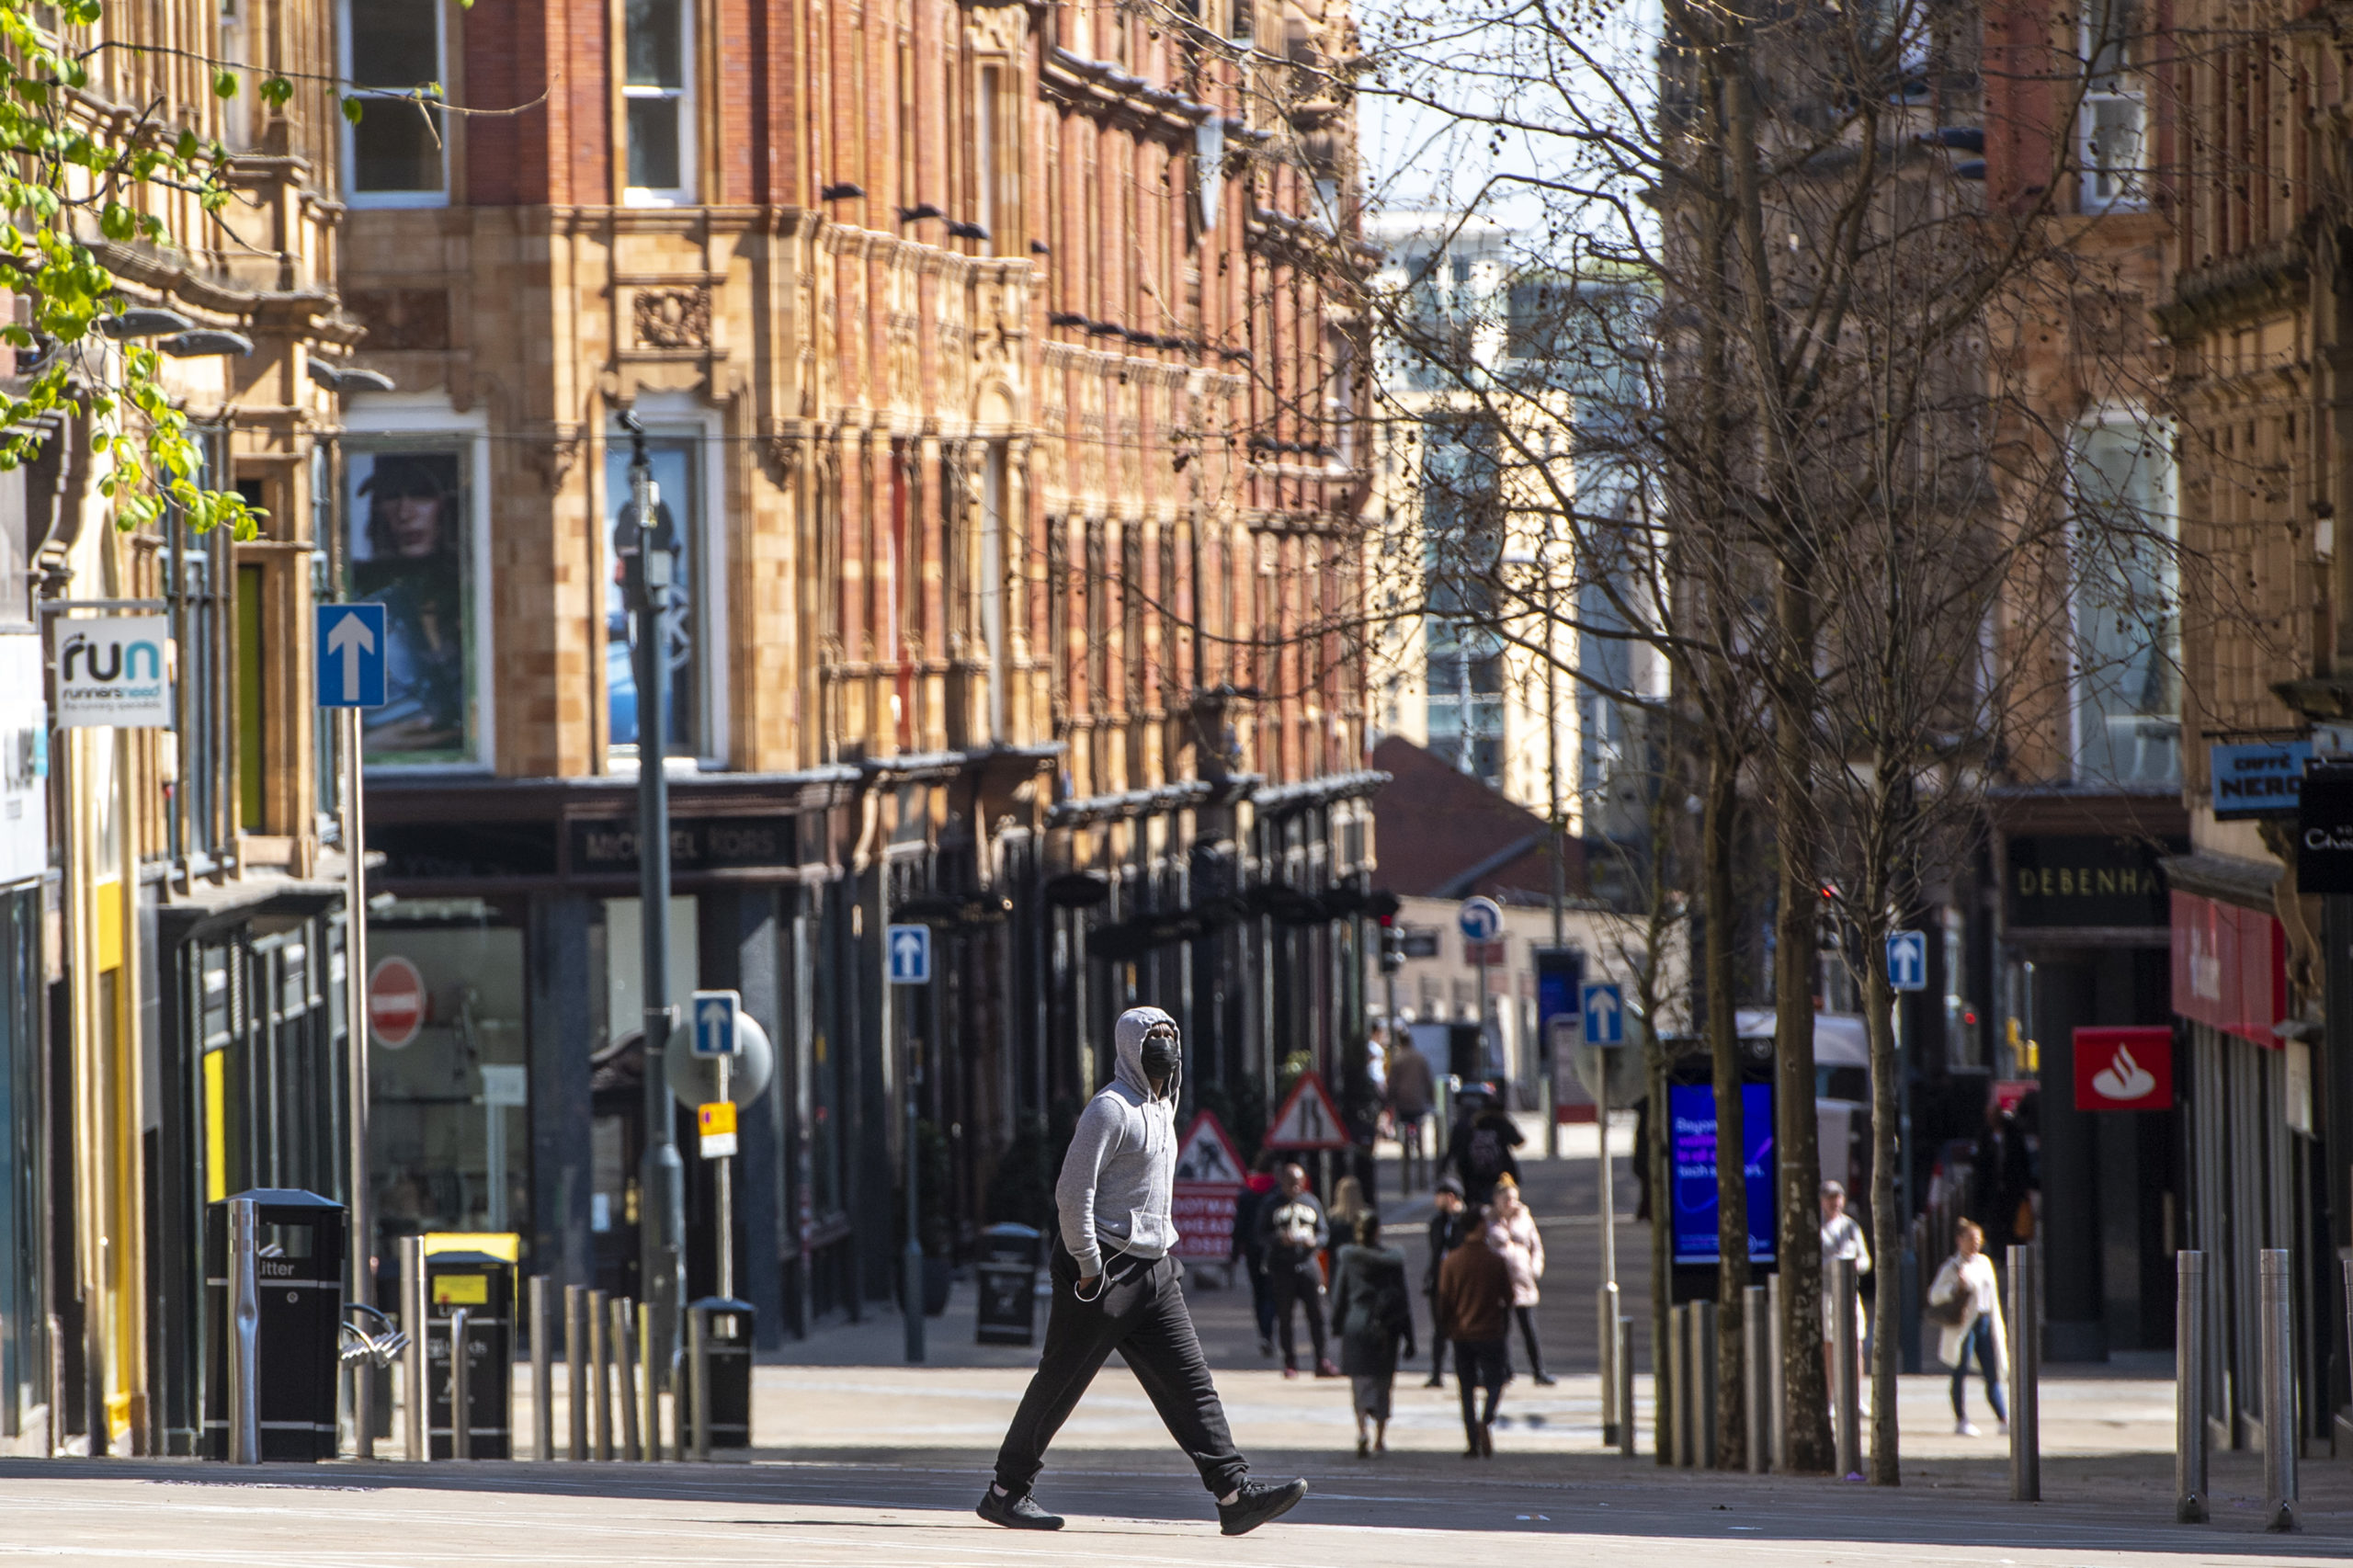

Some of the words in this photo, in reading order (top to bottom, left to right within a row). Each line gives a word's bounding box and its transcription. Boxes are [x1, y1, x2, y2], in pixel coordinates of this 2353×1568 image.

[63, 639, 159, 682] run
[2018, 868, 2161, 896] DEBENHA
[258, 1261, 295, 1276] itter
